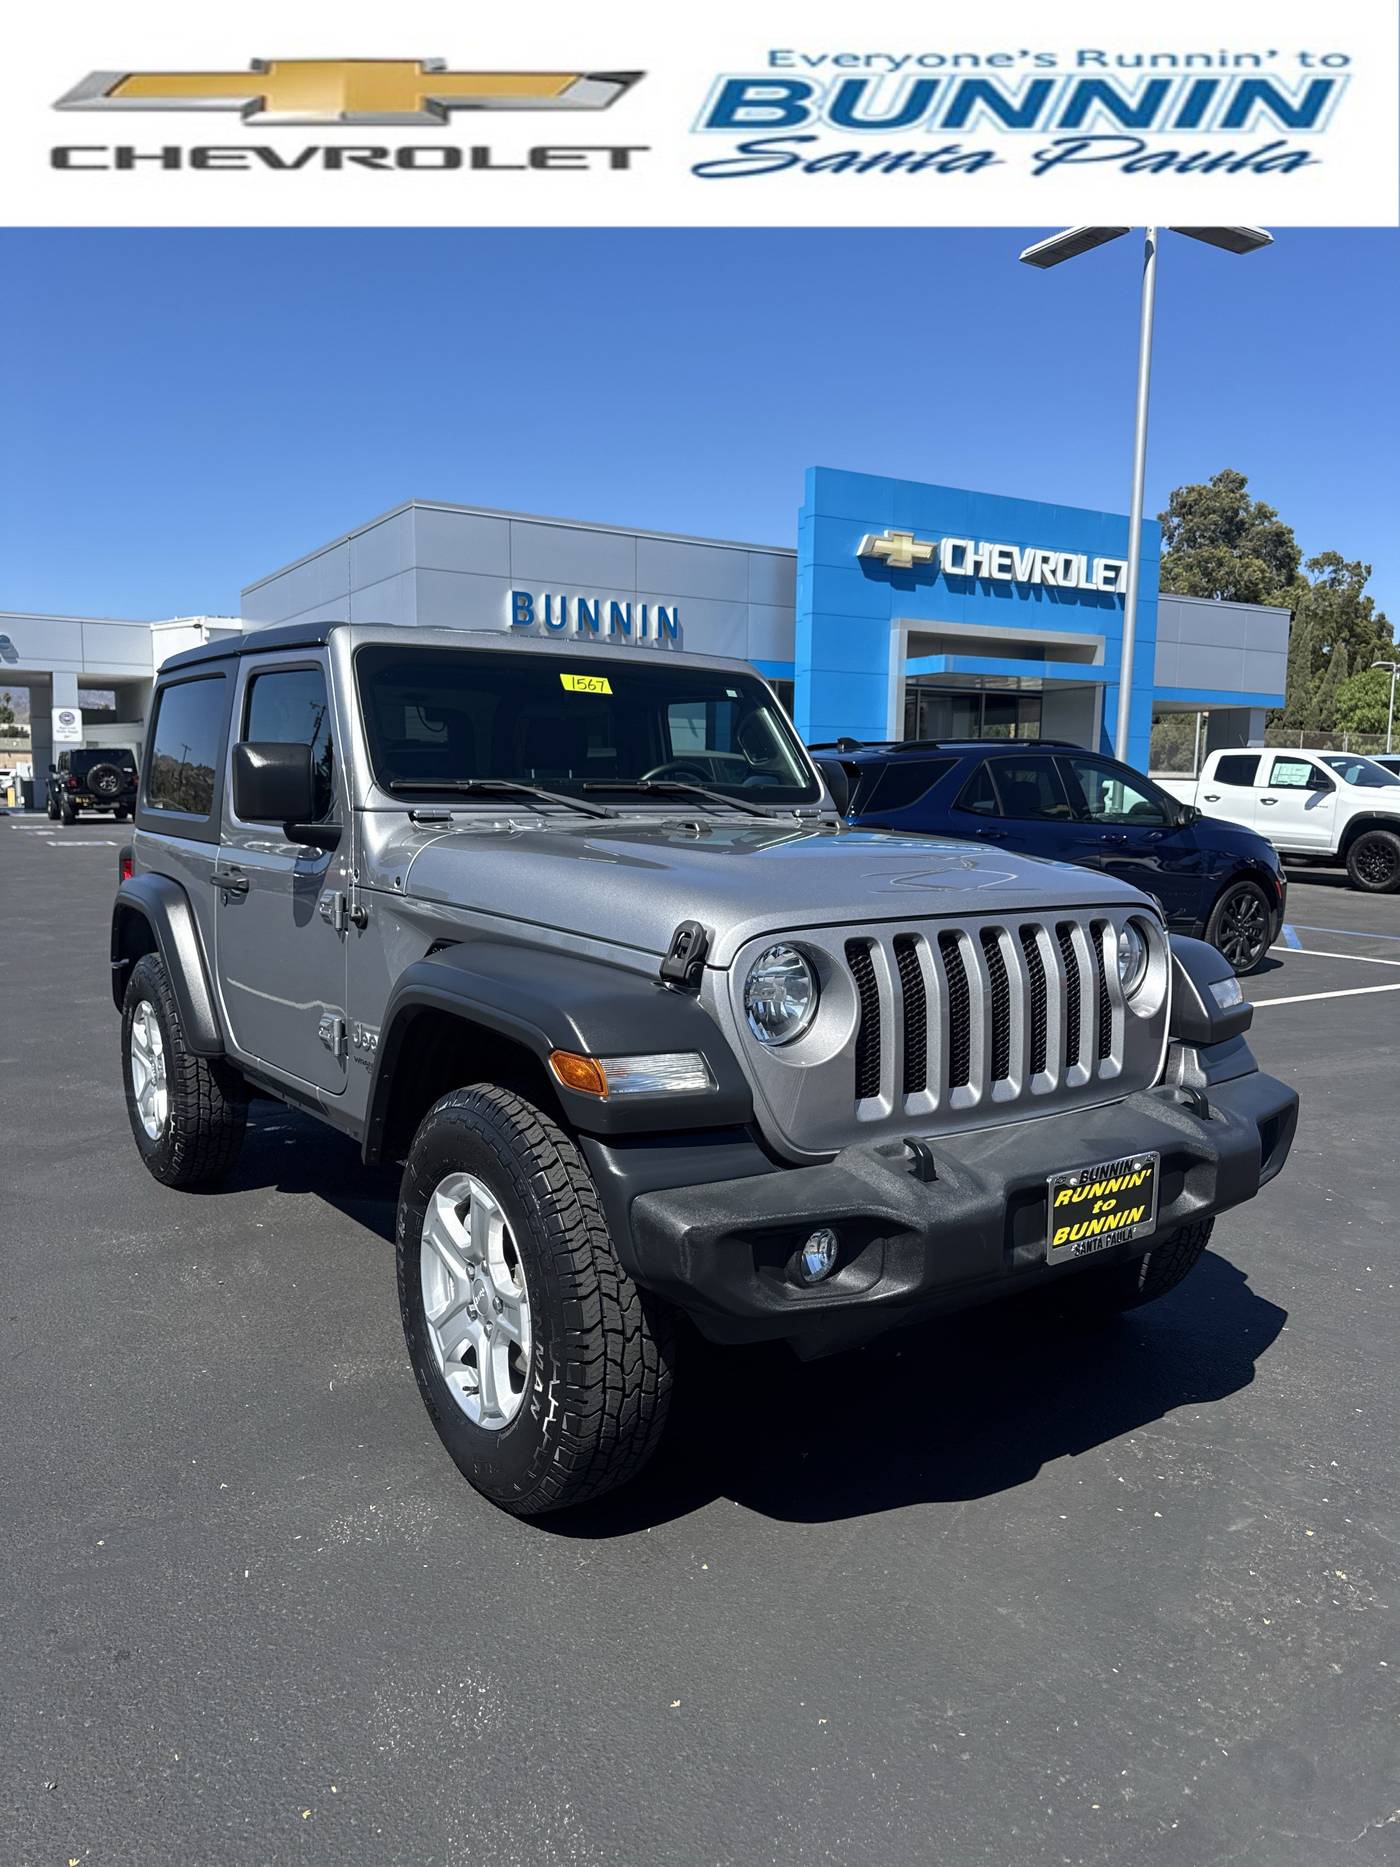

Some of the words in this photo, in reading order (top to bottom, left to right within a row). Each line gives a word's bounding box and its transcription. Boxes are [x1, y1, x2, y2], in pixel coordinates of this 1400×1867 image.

[940, 537, 1129, 593] CHEVROLET
[508, 590, 679, 640] BUNNIN
[571, 676, 605, 692] 1567
[1054, 1169, 1152, 1207] RUNNIN'
[1079, 1159, 1134, 1184] BUNNIN
[1092, 1199, 1117, 1213] to
[1053, 1205, 1145, 1246] BUNNIN
[1074, 1237, 1103, 1256] SANTA
[1106, 1228, 1133, 1247] PAULA
